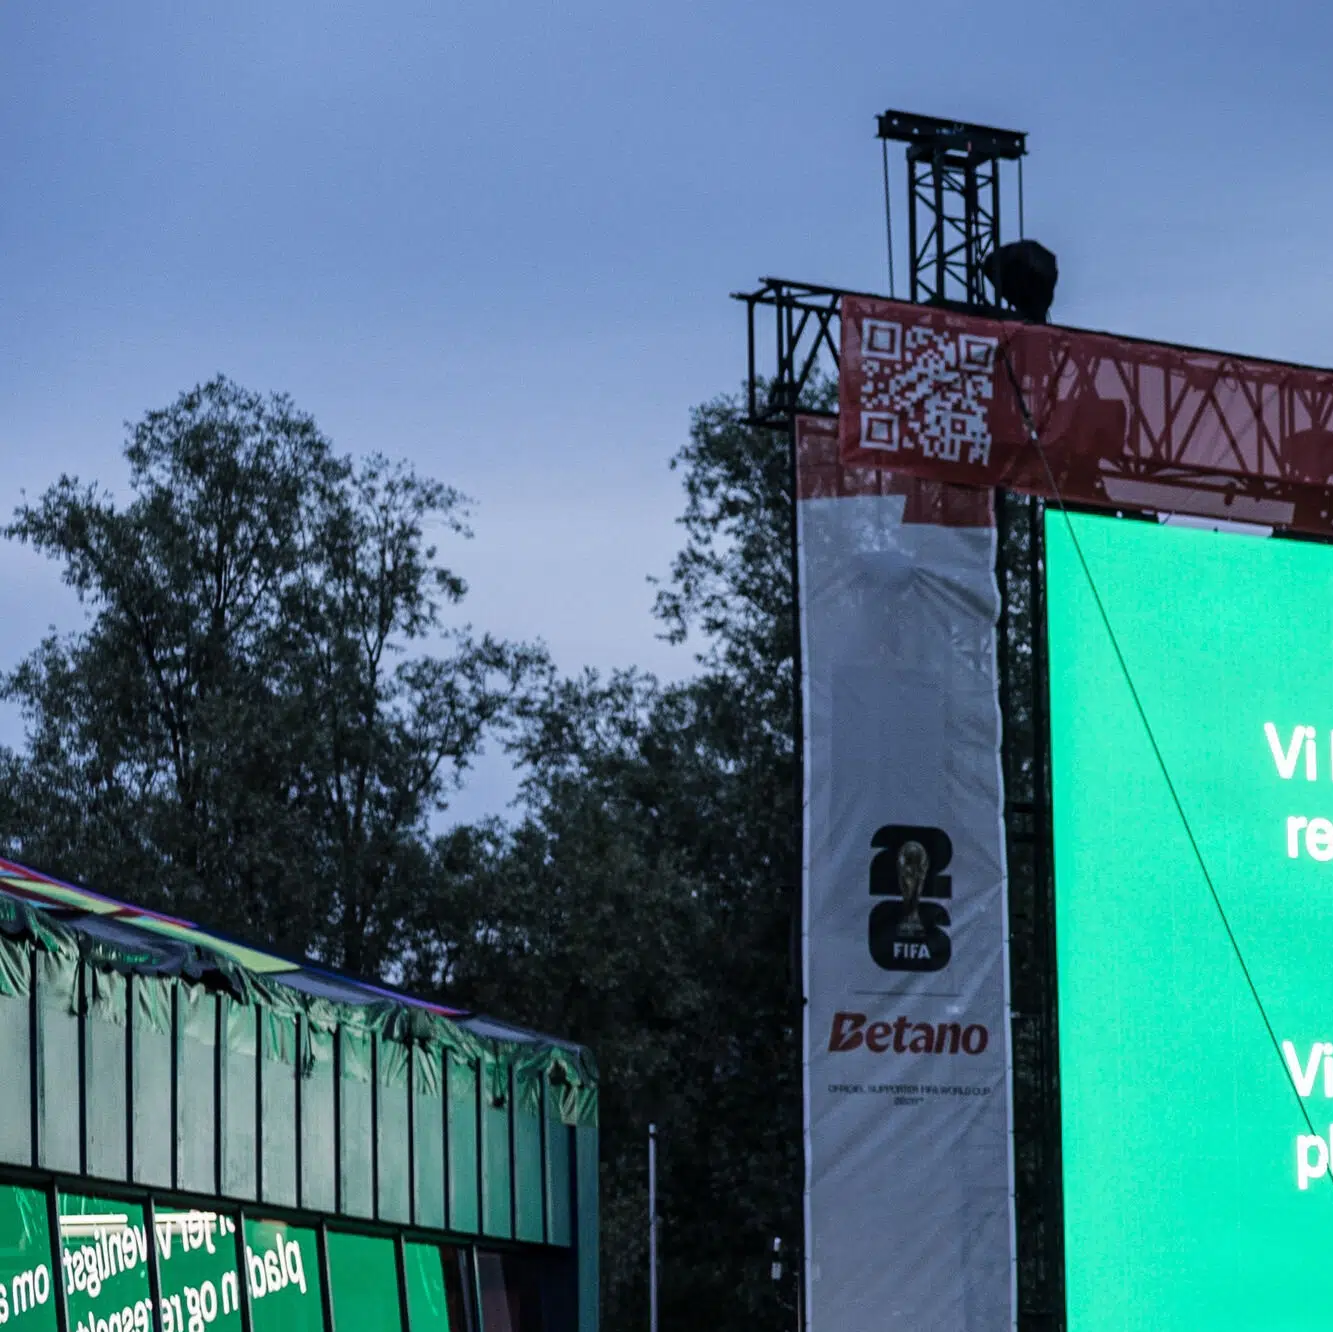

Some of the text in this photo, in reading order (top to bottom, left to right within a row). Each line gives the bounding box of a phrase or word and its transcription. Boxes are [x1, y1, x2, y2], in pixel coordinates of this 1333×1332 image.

[1264, 722, 1317, 781] Vi
[893, 942, 931, 959] FIFA
[828, 1012, 989, 1056] Betano
